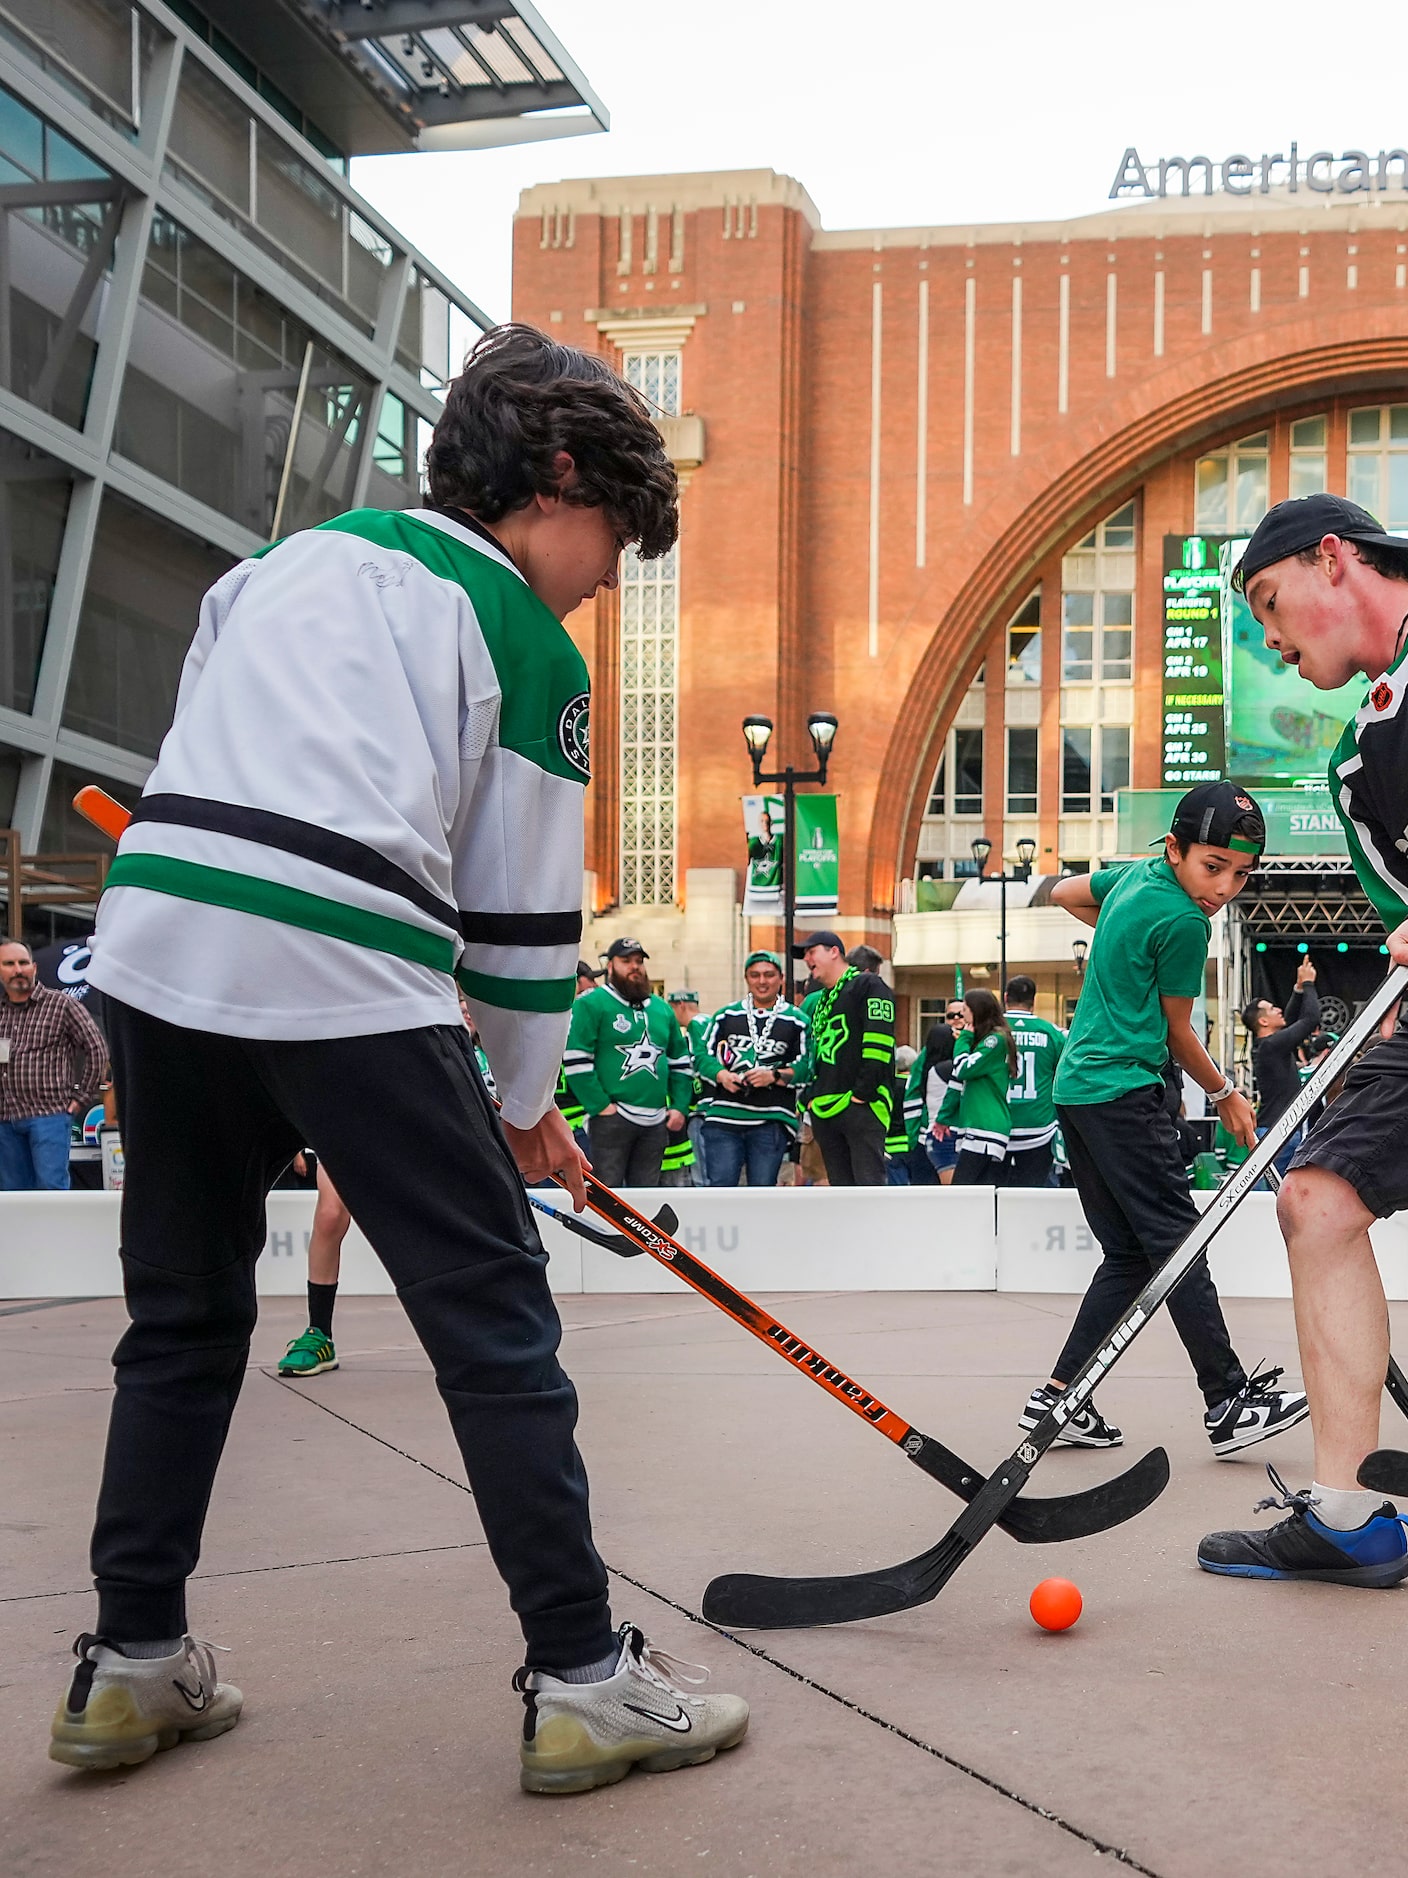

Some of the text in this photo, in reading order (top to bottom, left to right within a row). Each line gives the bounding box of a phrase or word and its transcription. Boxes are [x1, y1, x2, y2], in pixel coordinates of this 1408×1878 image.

[1166, 609, 1209, 620] ROUND
[1165, 637, 1209, 648] APR 17
[1165, 666, 1191, 677] APR
[1165, 724, 1190, 735] APR
[1164, 753, 1190, 763] APR
[1164, 770, 1221, 781] GO STARS!
[867, 998, 895, 1022] 29
[623, 1216, 657, 1245] COMP
[1052, 1307, 1147, 1426] Franklin
[766, 1324, 889, 1423] Franklin
